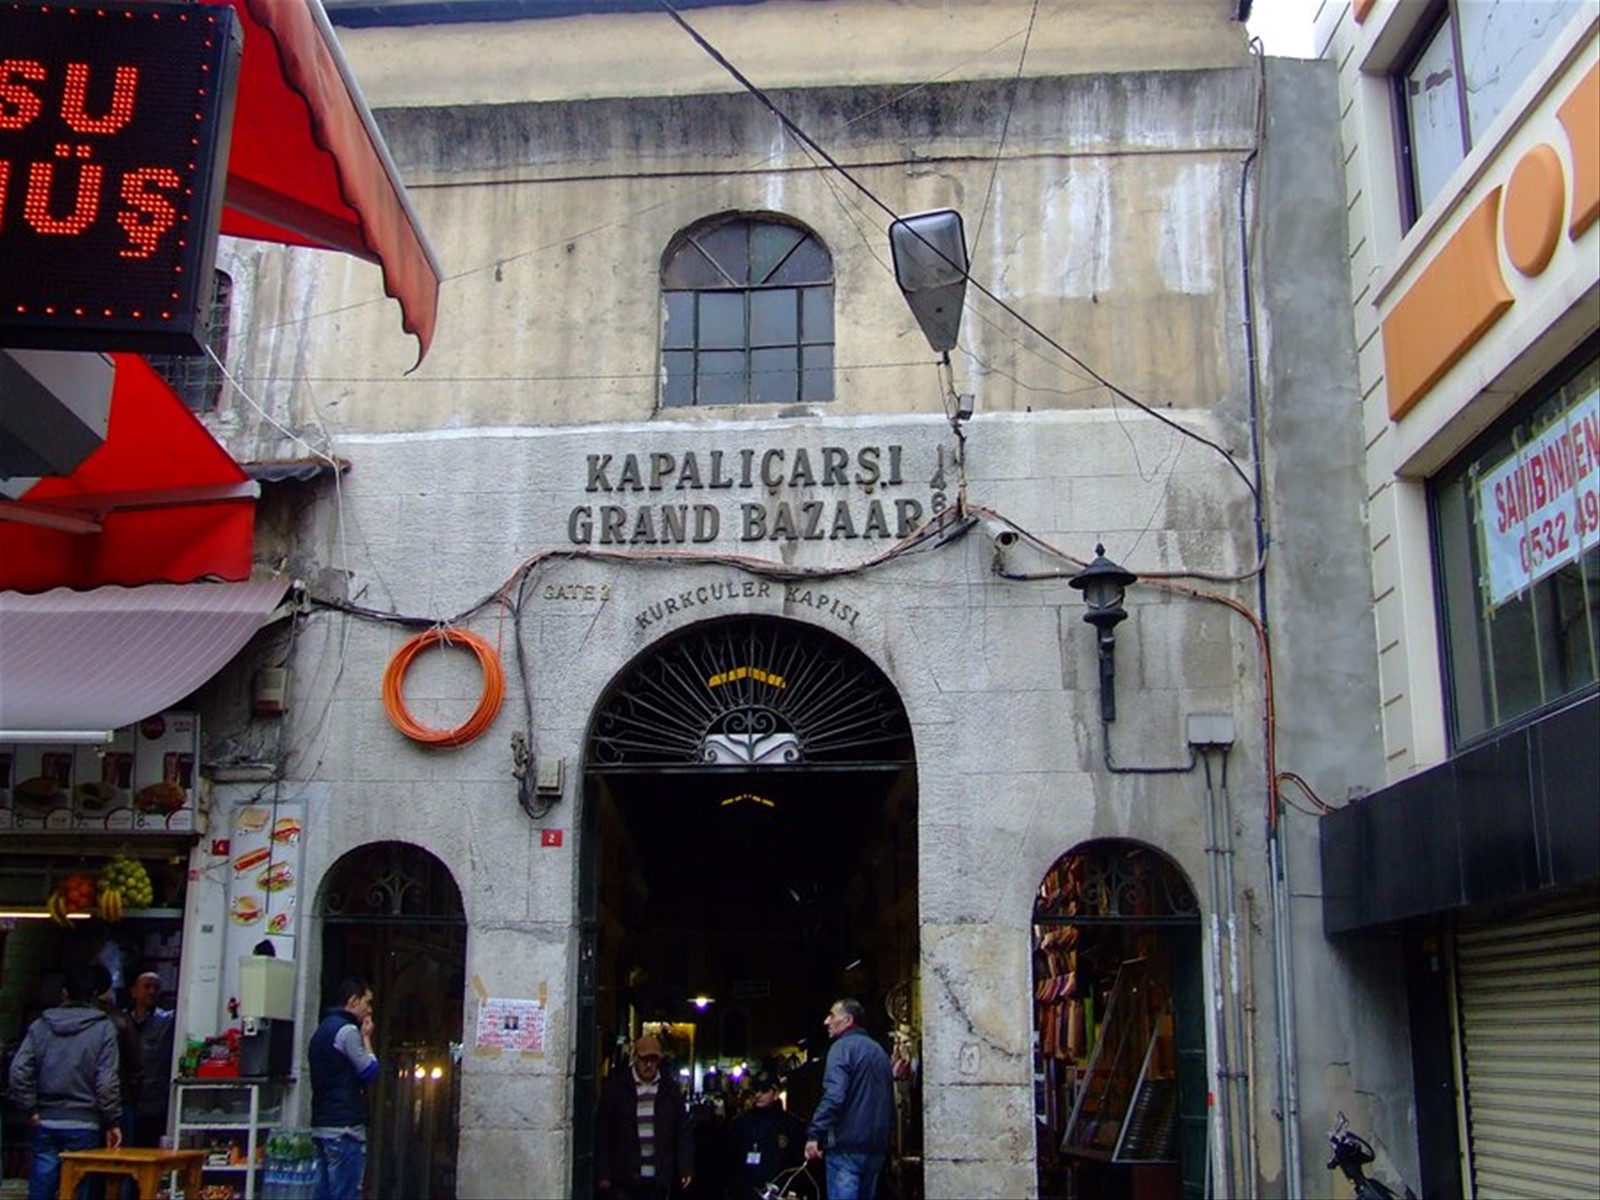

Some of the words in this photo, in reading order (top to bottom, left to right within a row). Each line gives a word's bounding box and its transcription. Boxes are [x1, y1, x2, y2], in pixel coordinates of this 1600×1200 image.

[0, 143, 181, 258] ÜŞ
[568, 504, 720, 545] GRAND
[740, 498, 924, 543] BAZAAR
[1519, 510, 1570, 574] 0532
[544, 583, 595, 600] GATE
[785, 586, 862, 627] KAPISI
